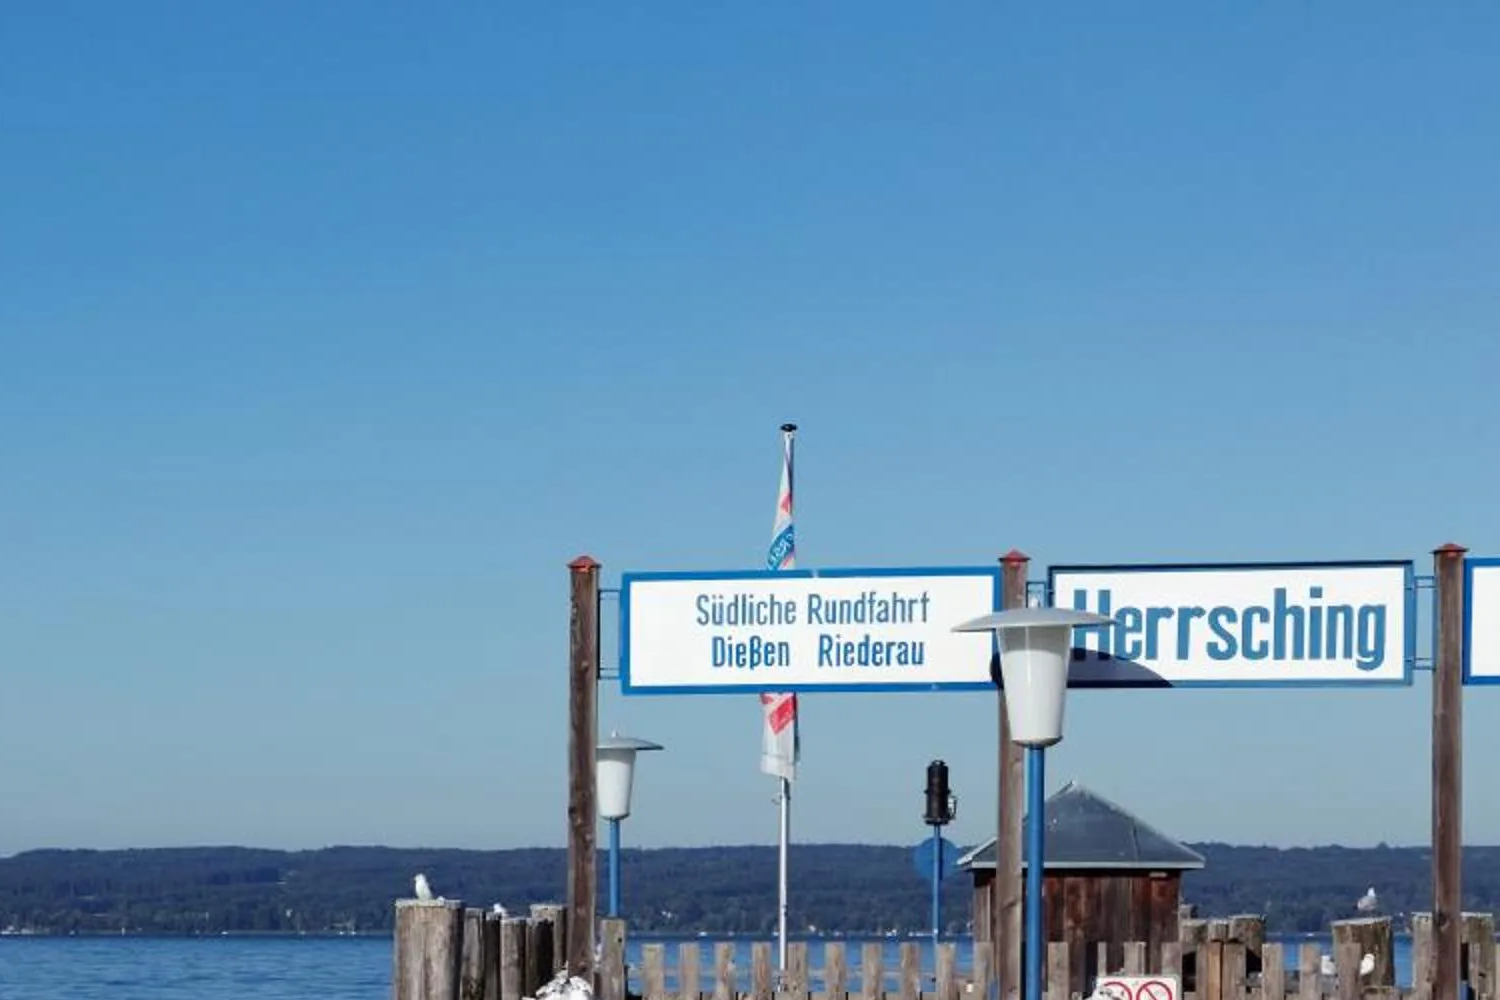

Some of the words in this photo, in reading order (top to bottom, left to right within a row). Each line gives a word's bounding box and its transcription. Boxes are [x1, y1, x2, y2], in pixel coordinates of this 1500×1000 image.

[696, 592, 797, 626] Südliche
[807, 591, 931, 625] Rundfahrt
[1072, 586, 1387, 673] Herrsching
[711, 635, 791, 671] Dießen
[817, 632, 925, 668] Riederau
